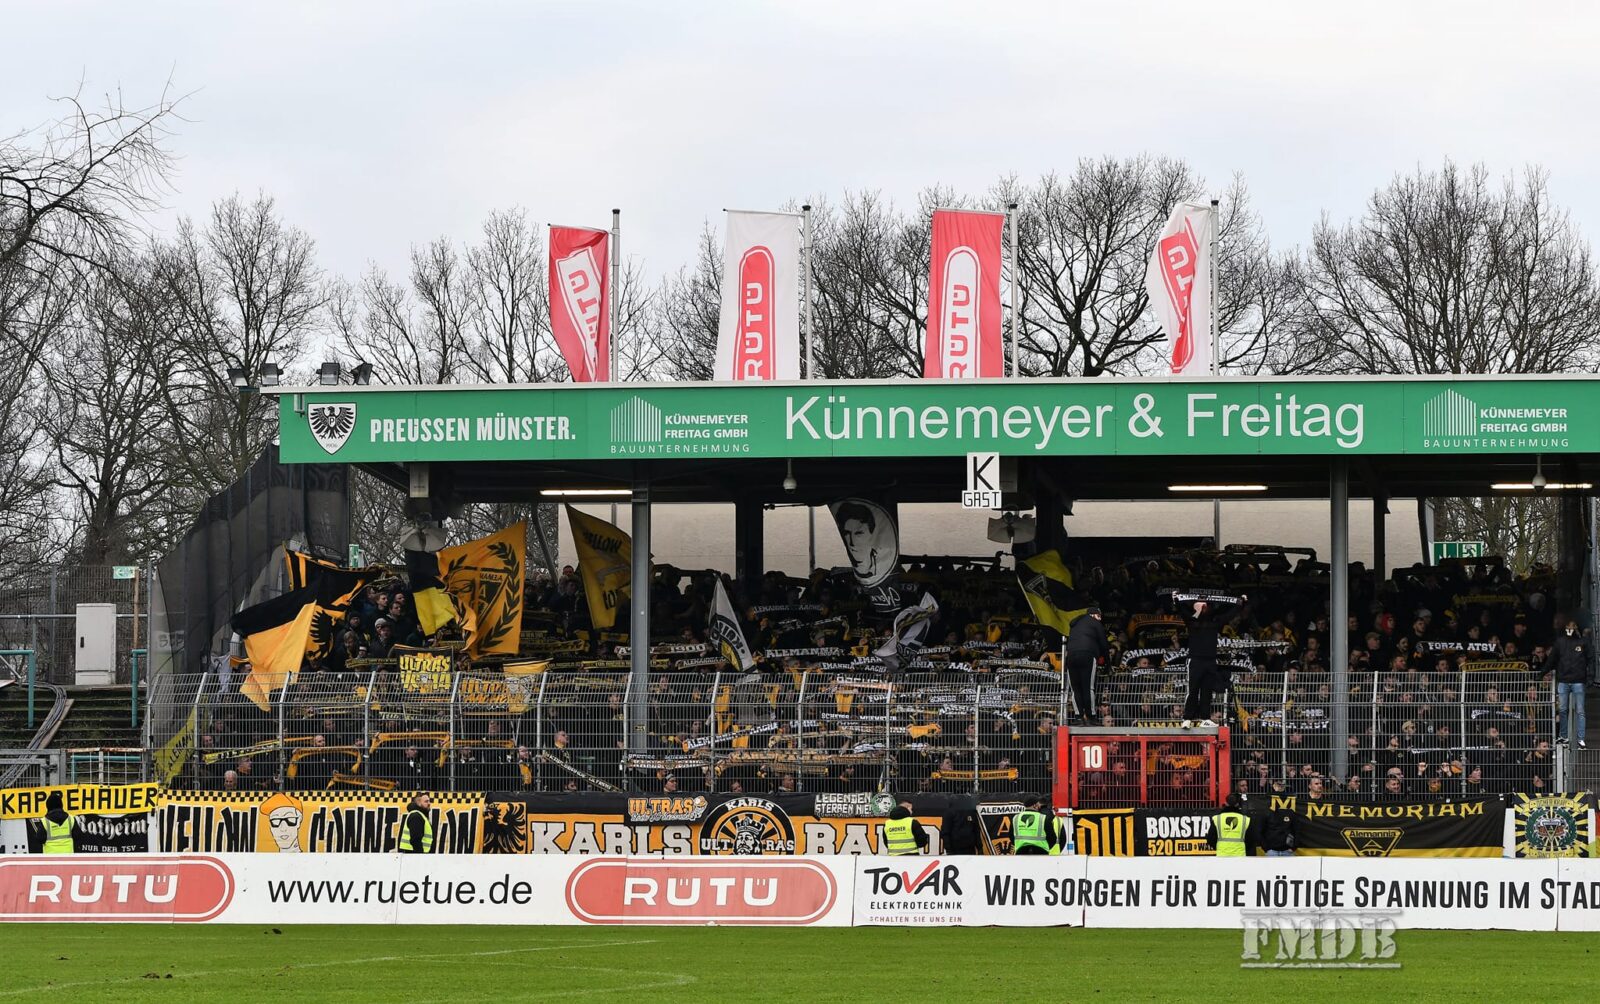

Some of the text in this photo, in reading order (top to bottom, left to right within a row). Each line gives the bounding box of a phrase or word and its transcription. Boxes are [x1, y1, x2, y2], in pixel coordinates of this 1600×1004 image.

[744, 282, 763, 380] RÜTÜ
[664, 413, 749, 425] KÜNNEMEYER
[785, 393, 1364, 449] Künnemeyer & Freitag
[1480, 407, 1568, 418] KÜNNEMEYER
[476, 412, 576, 441] MÜNSTER.
[664, 429, 749, 438] FREITAG GMBH
[1480, 423, 1568, 432] FREITAG GMBH
[610, 443, 750, 454] BAUUNTERNEHMUNG
[1423, 438, 1569, 448] BAUUNTERNEHMUNG
[973, 456, 995, 490] K
[964, 492, 1000, 508] GAST
[1428, 641, 1497, 652] FORZA ATSV
[1082, 745, 1103, 769] 10
[725, 798, 775, 812] KARLS
[1305, 801, 1485, 821] MEMORIAM
[1148, 839, 1173, 856] 520
[28, 874, 179, 904] RÜTÜ
[268, 873, 532, 905] www.ruetue.de
[623, 876, 779, 906] RÜTÜ
[984, 874, 1035, 906] WIR
[1044, 878, 1140, 907] SORGEN
[1150, 875, 1198, 907] FÜR
[1207, 880, 1247, 907] DIE
[1256, 875, 1345, 908] NÖTIGE
[1354, 876, 1489, 908] SPANNUNG
[1500, 881, 1530, 909] IM
[870, 901, 963, 910] ELEKTROTECHNIK
